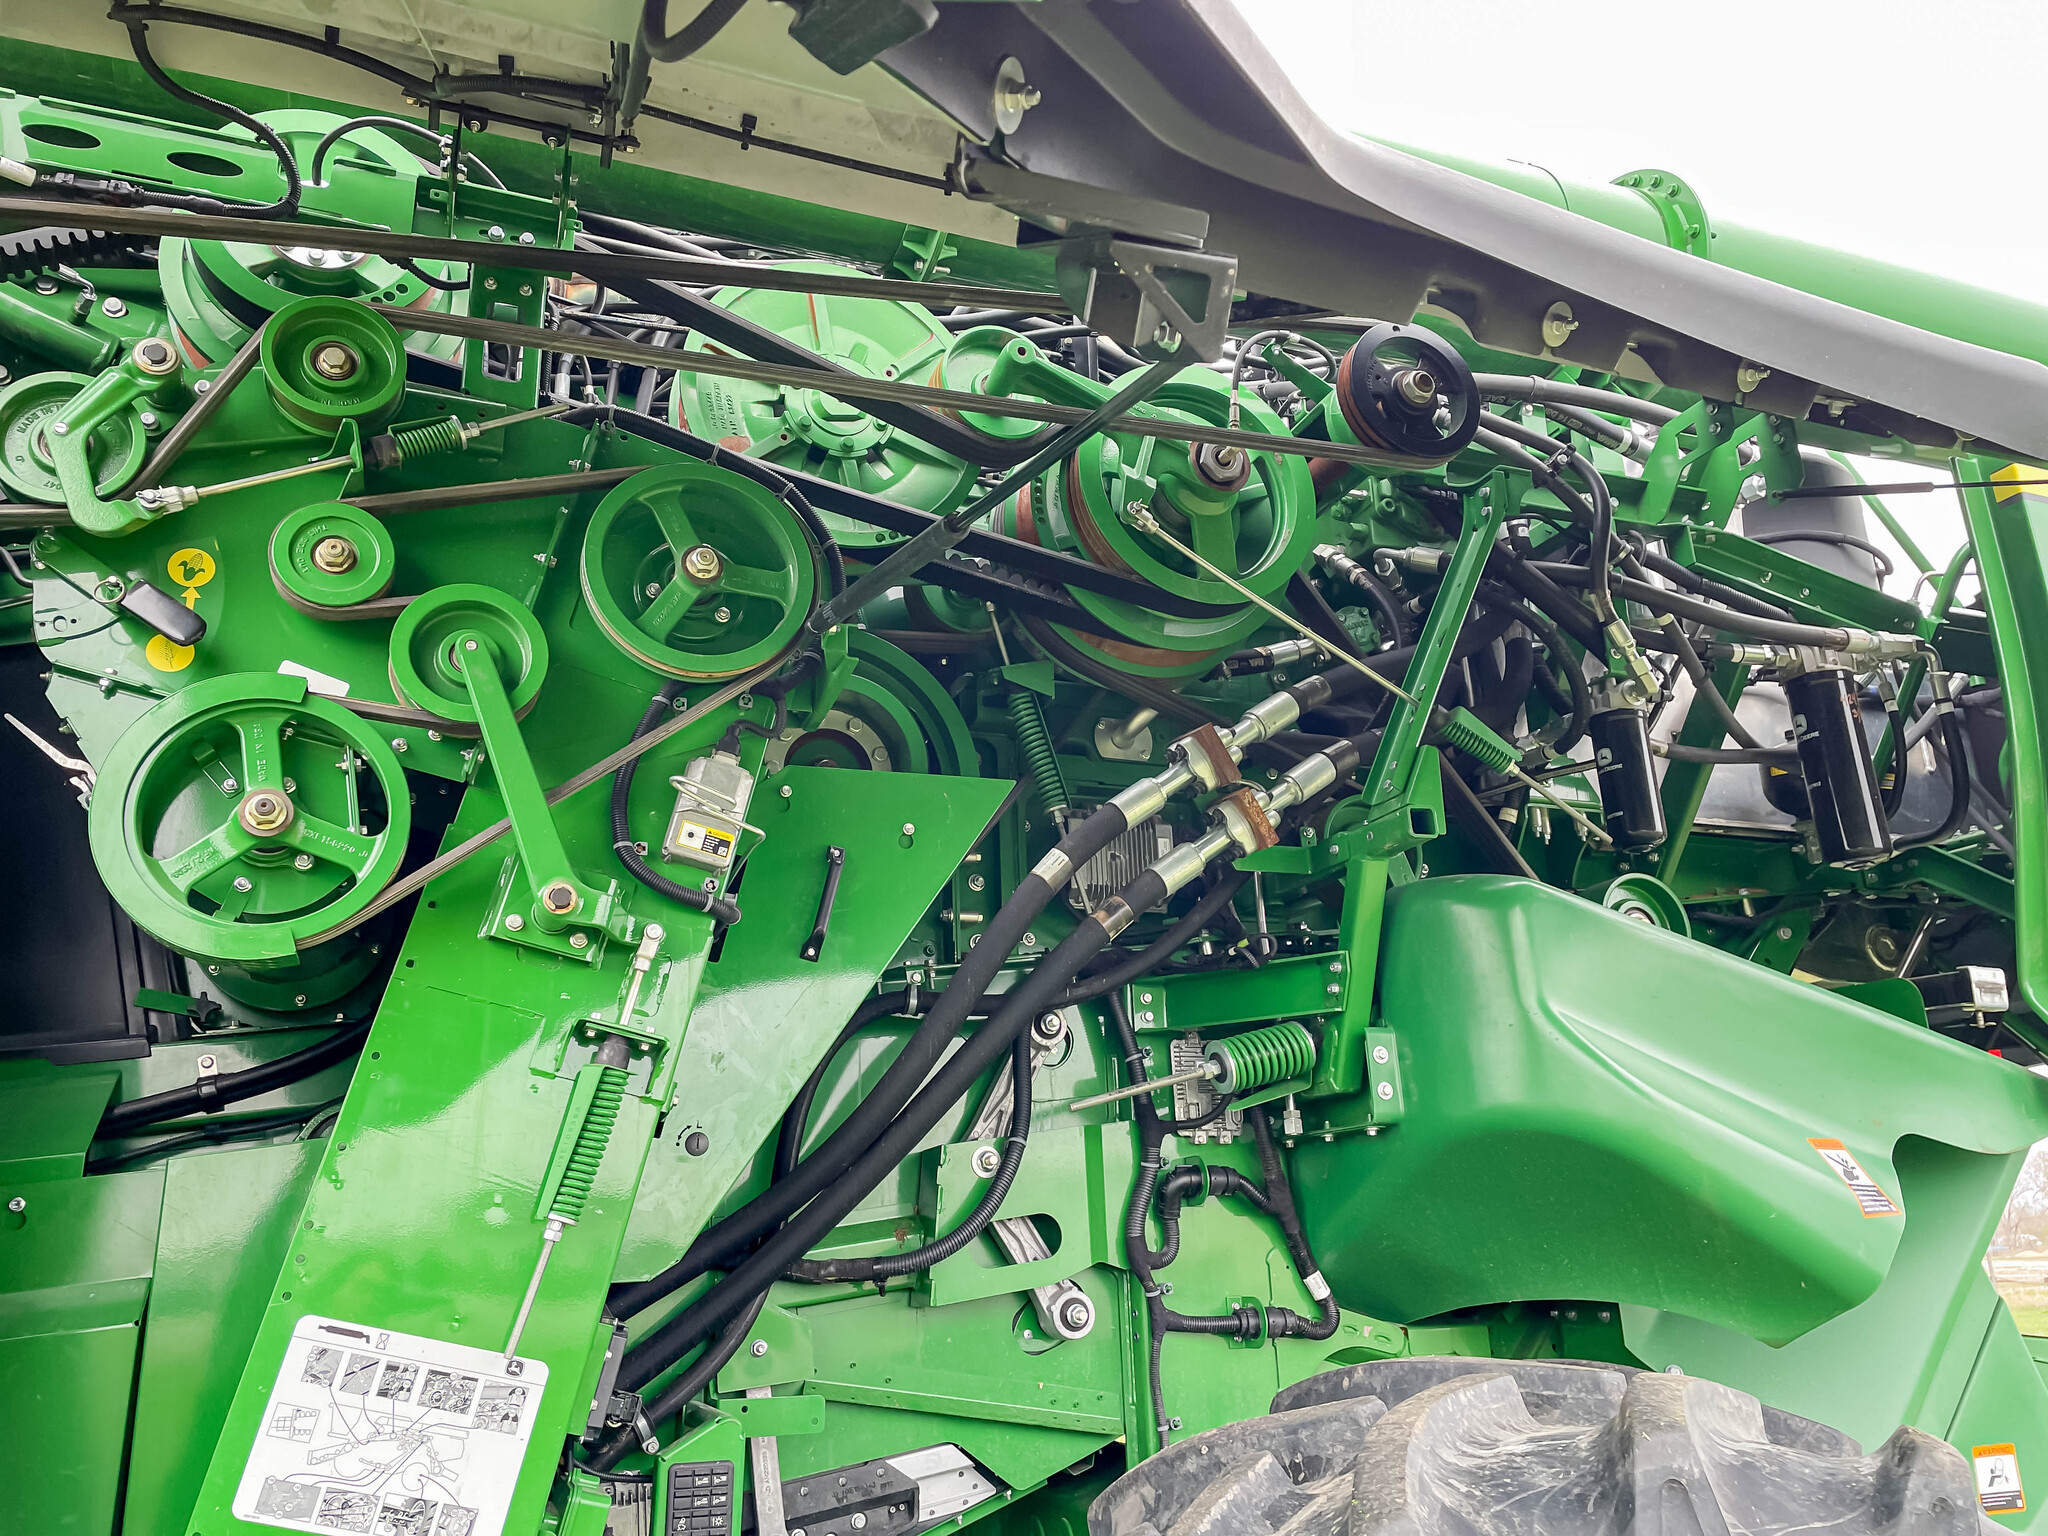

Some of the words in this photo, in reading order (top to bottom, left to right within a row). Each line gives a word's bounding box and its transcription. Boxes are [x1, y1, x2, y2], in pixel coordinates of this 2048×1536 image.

[17, 411, 40, 434] MADE
[254, 742, 264, 754] IN
[255, 759, 268, 782] MADE
[696, 1120, 702, 1128] L
